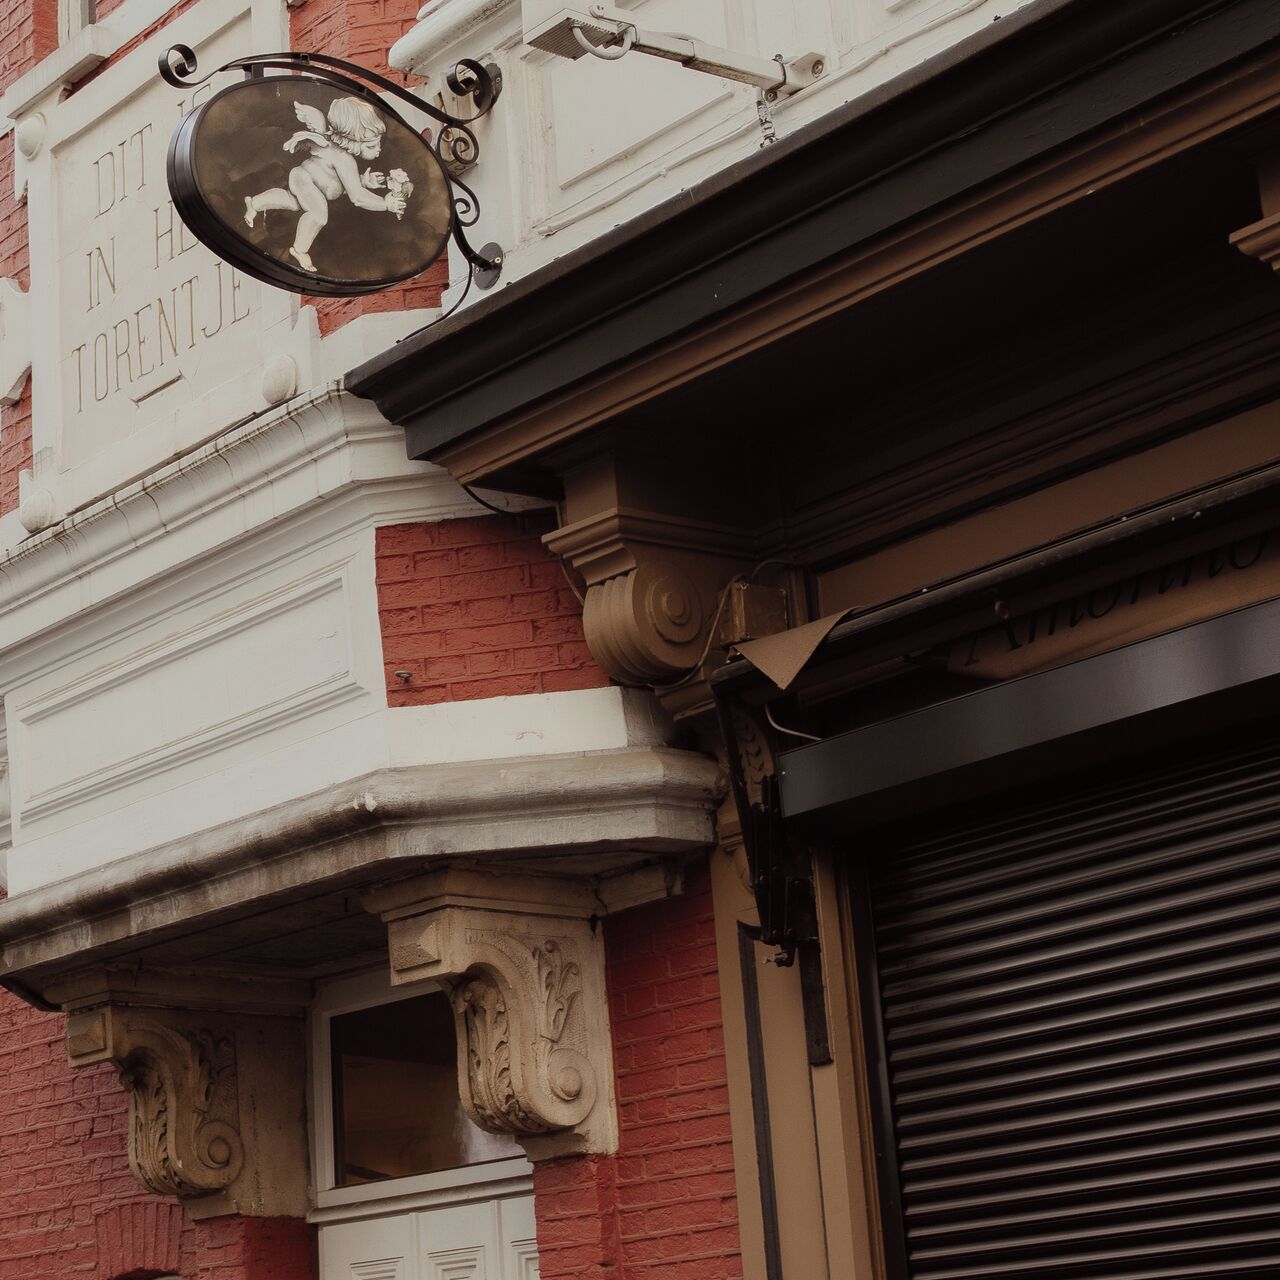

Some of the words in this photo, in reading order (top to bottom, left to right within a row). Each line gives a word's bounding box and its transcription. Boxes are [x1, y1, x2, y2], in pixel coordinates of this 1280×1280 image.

[93, 123, 153, 219] DIT
[86, 236, 117, 313] IN
[71, 261, 250, 414] TORENTJE
